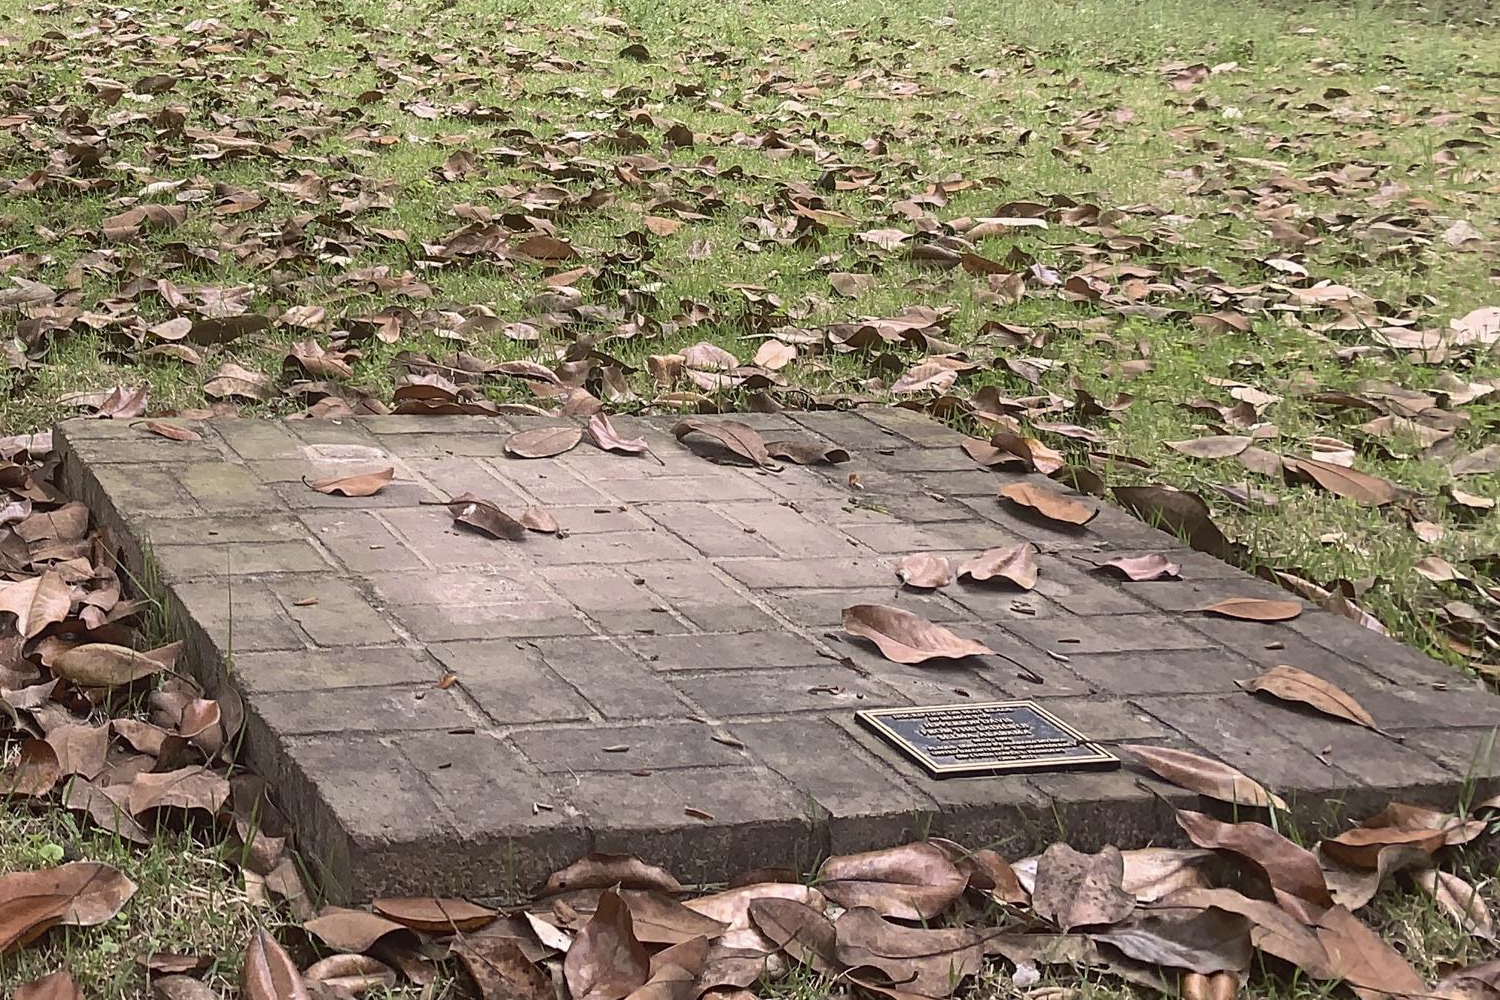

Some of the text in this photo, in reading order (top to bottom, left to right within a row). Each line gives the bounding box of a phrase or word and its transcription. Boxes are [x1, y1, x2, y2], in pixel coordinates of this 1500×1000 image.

[923, 717, 1013, 728] JEFFERSON DAVIS
[920, 728, 952, 736] FROM
[980, 729, 1032, 738] ALABAMA
